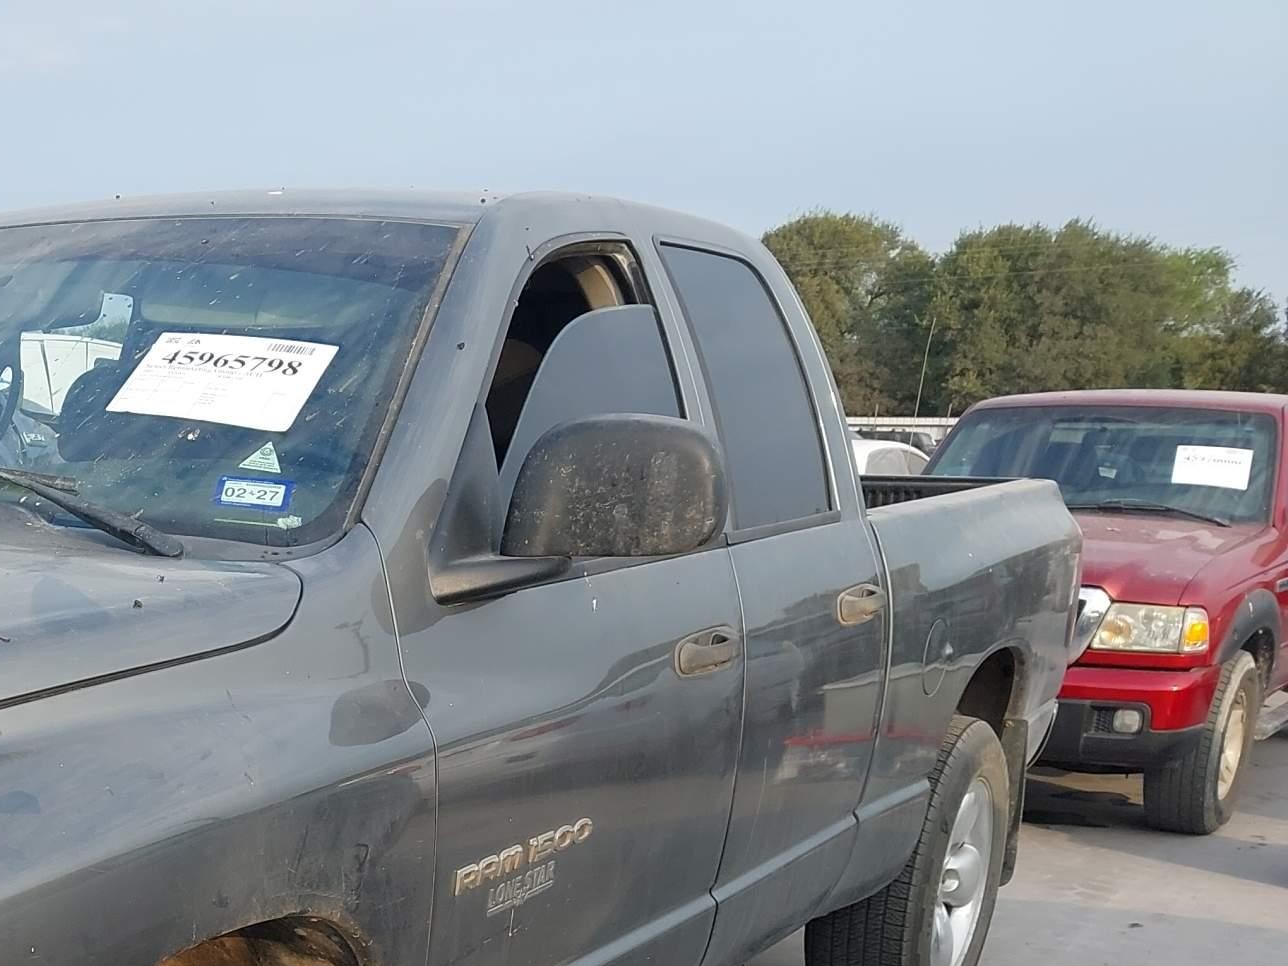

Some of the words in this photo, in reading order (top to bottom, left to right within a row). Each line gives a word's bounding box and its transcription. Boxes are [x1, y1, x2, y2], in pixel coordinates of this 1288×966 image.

[161, 349, 303, 377] 45965798
[224, 486, 247, 499] 02
[255, 489, 280, 501] 27
[453, 843, 524, 897] RAM
[526, 817, 593, 864] 1500
